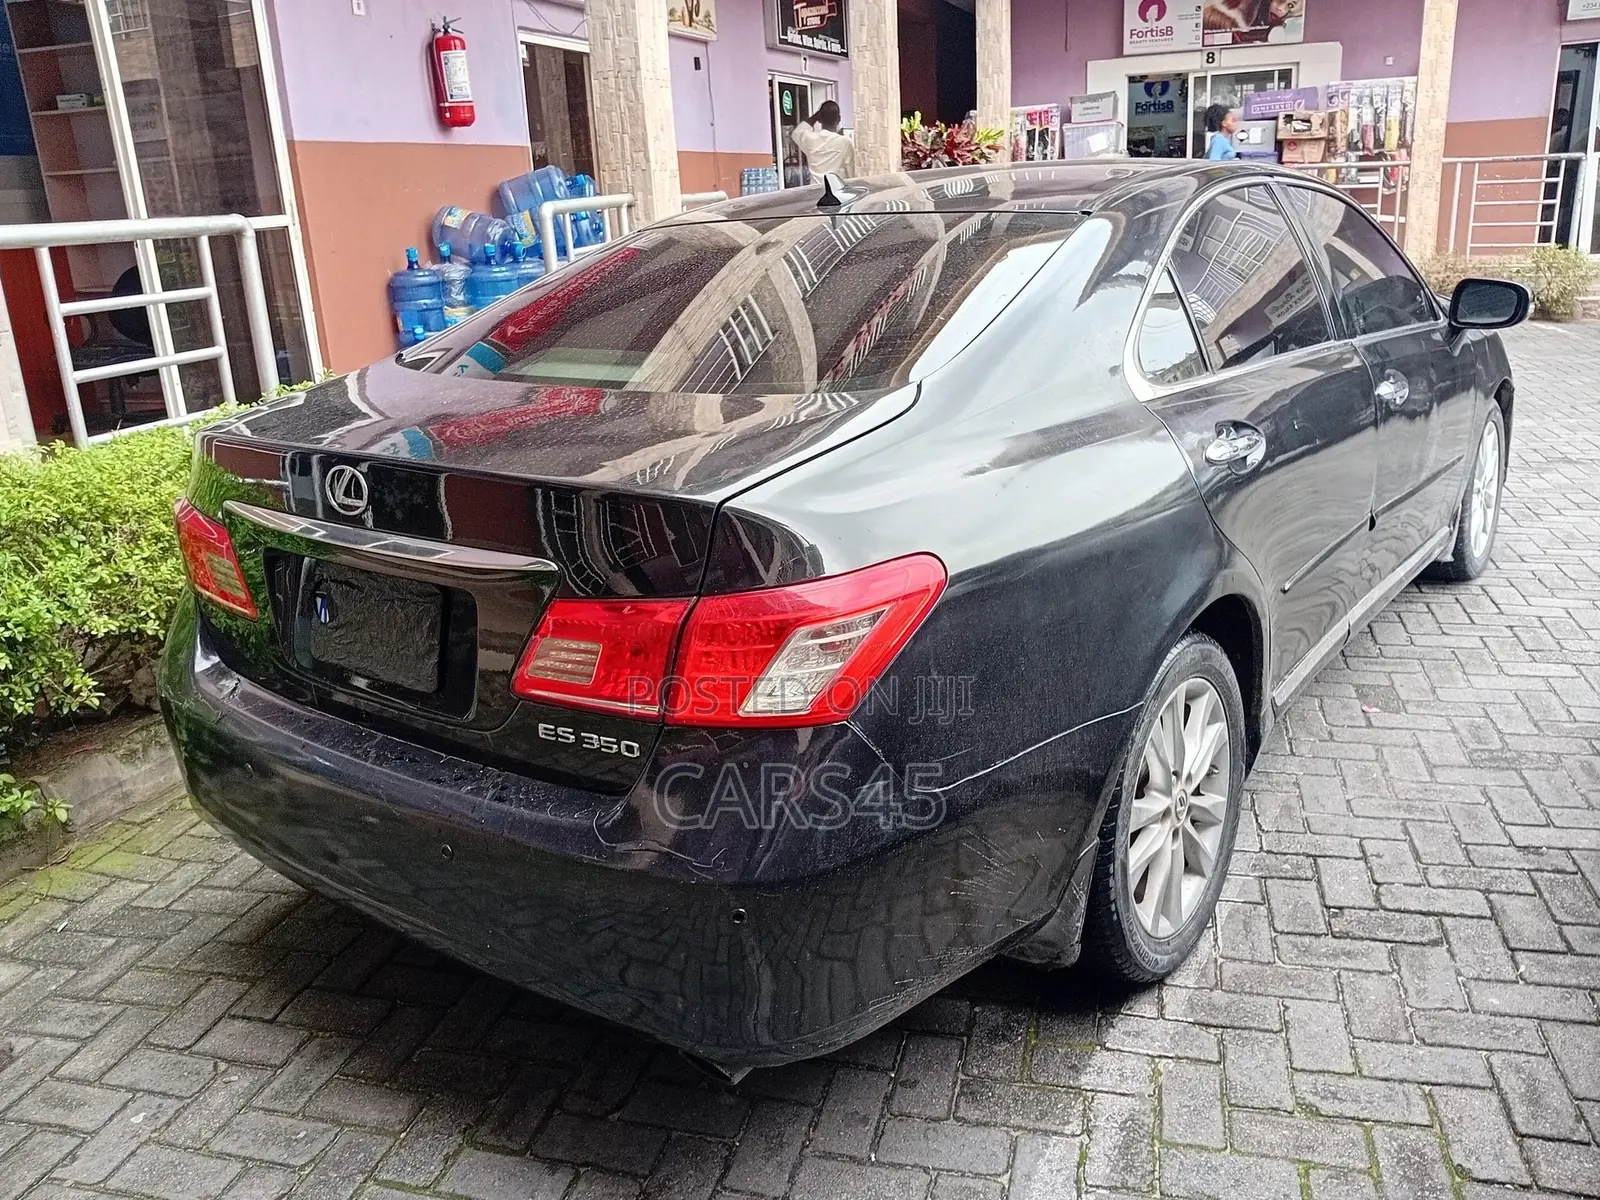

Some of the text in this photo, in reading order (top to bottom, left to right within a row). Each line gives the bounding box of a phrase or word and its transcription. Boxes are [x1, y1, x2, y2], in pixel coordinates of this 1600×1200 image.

[1129, 26, 1174, 40] FortisB
[1205, 52, 1216, 64] 8
[1135, 100, 1175, 112] FortisB
[538, 723, 641, 758] ES 350
